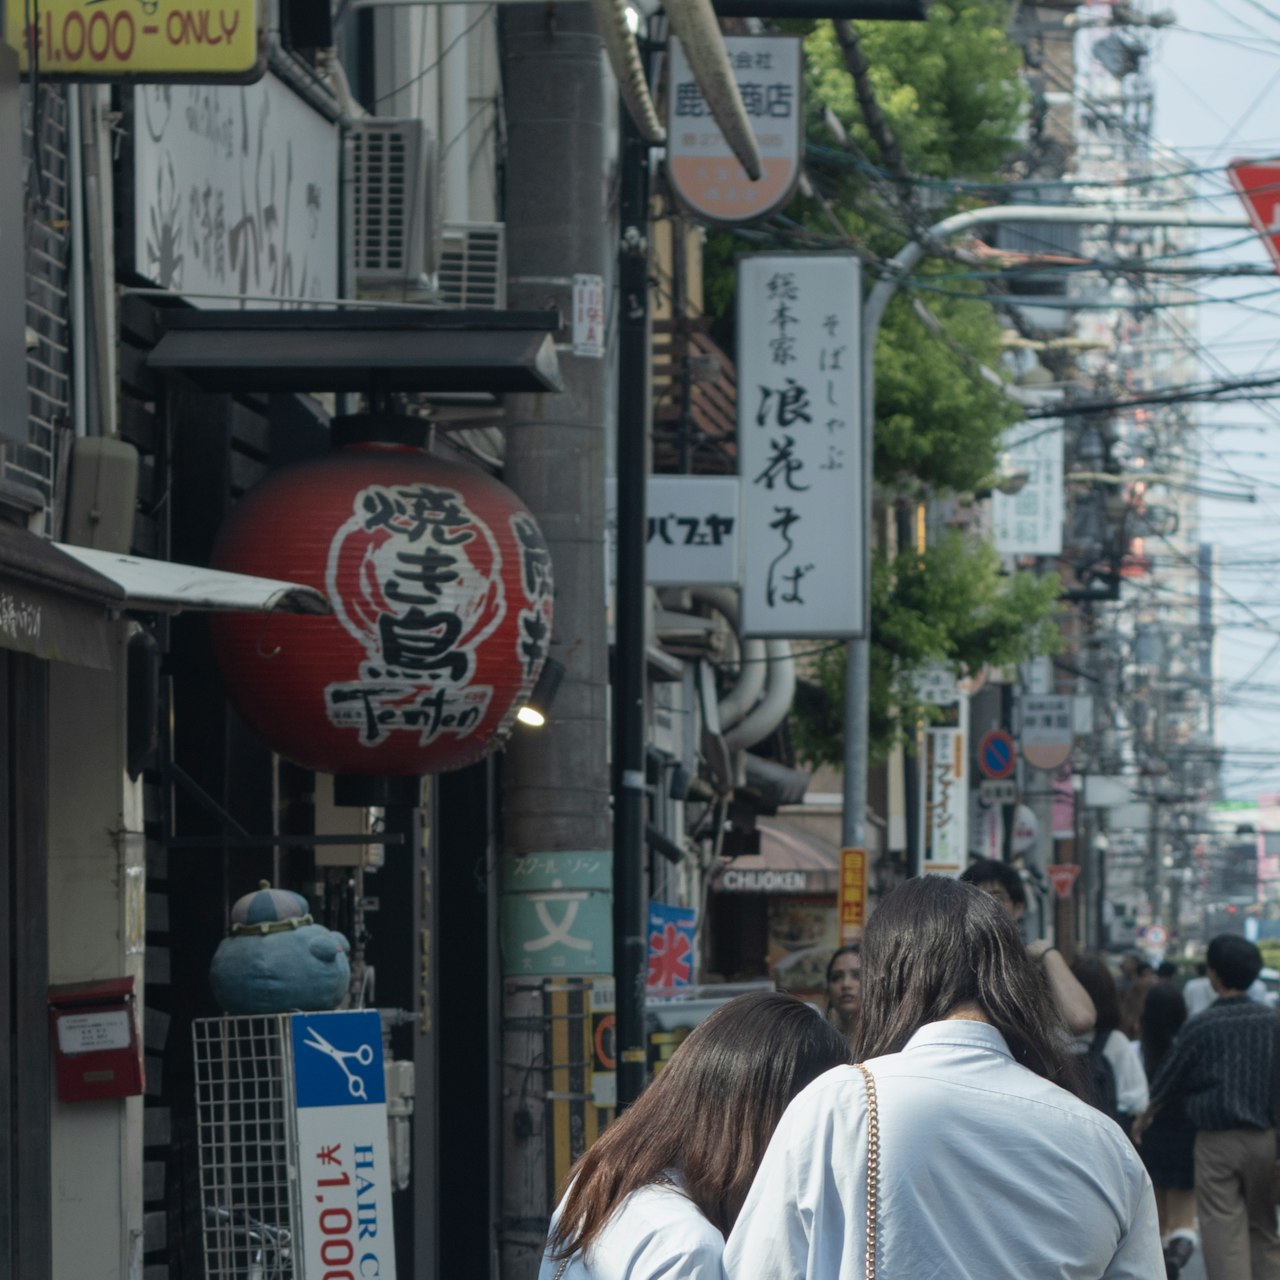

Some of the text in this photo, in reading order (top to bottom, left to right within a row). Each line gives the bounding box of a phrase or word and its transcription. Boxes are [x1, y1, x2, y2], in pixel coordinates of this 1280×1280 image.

[166, 9, 239, 46] ONLY
[675, 81, 793, 119] 鹿商店
[765, 272, 801, 367] 総本家
[819, 313, 848, 471] そばしゃぶ
[753, 377, 816, 609] 浪花そば
[361, 485, 477, 683] 焼き鳥
[722, 868, 807, 892] CHUOKEN
[645, 923, 692, 990] 氷
[353, 1144, 379, 1243] HAIR
